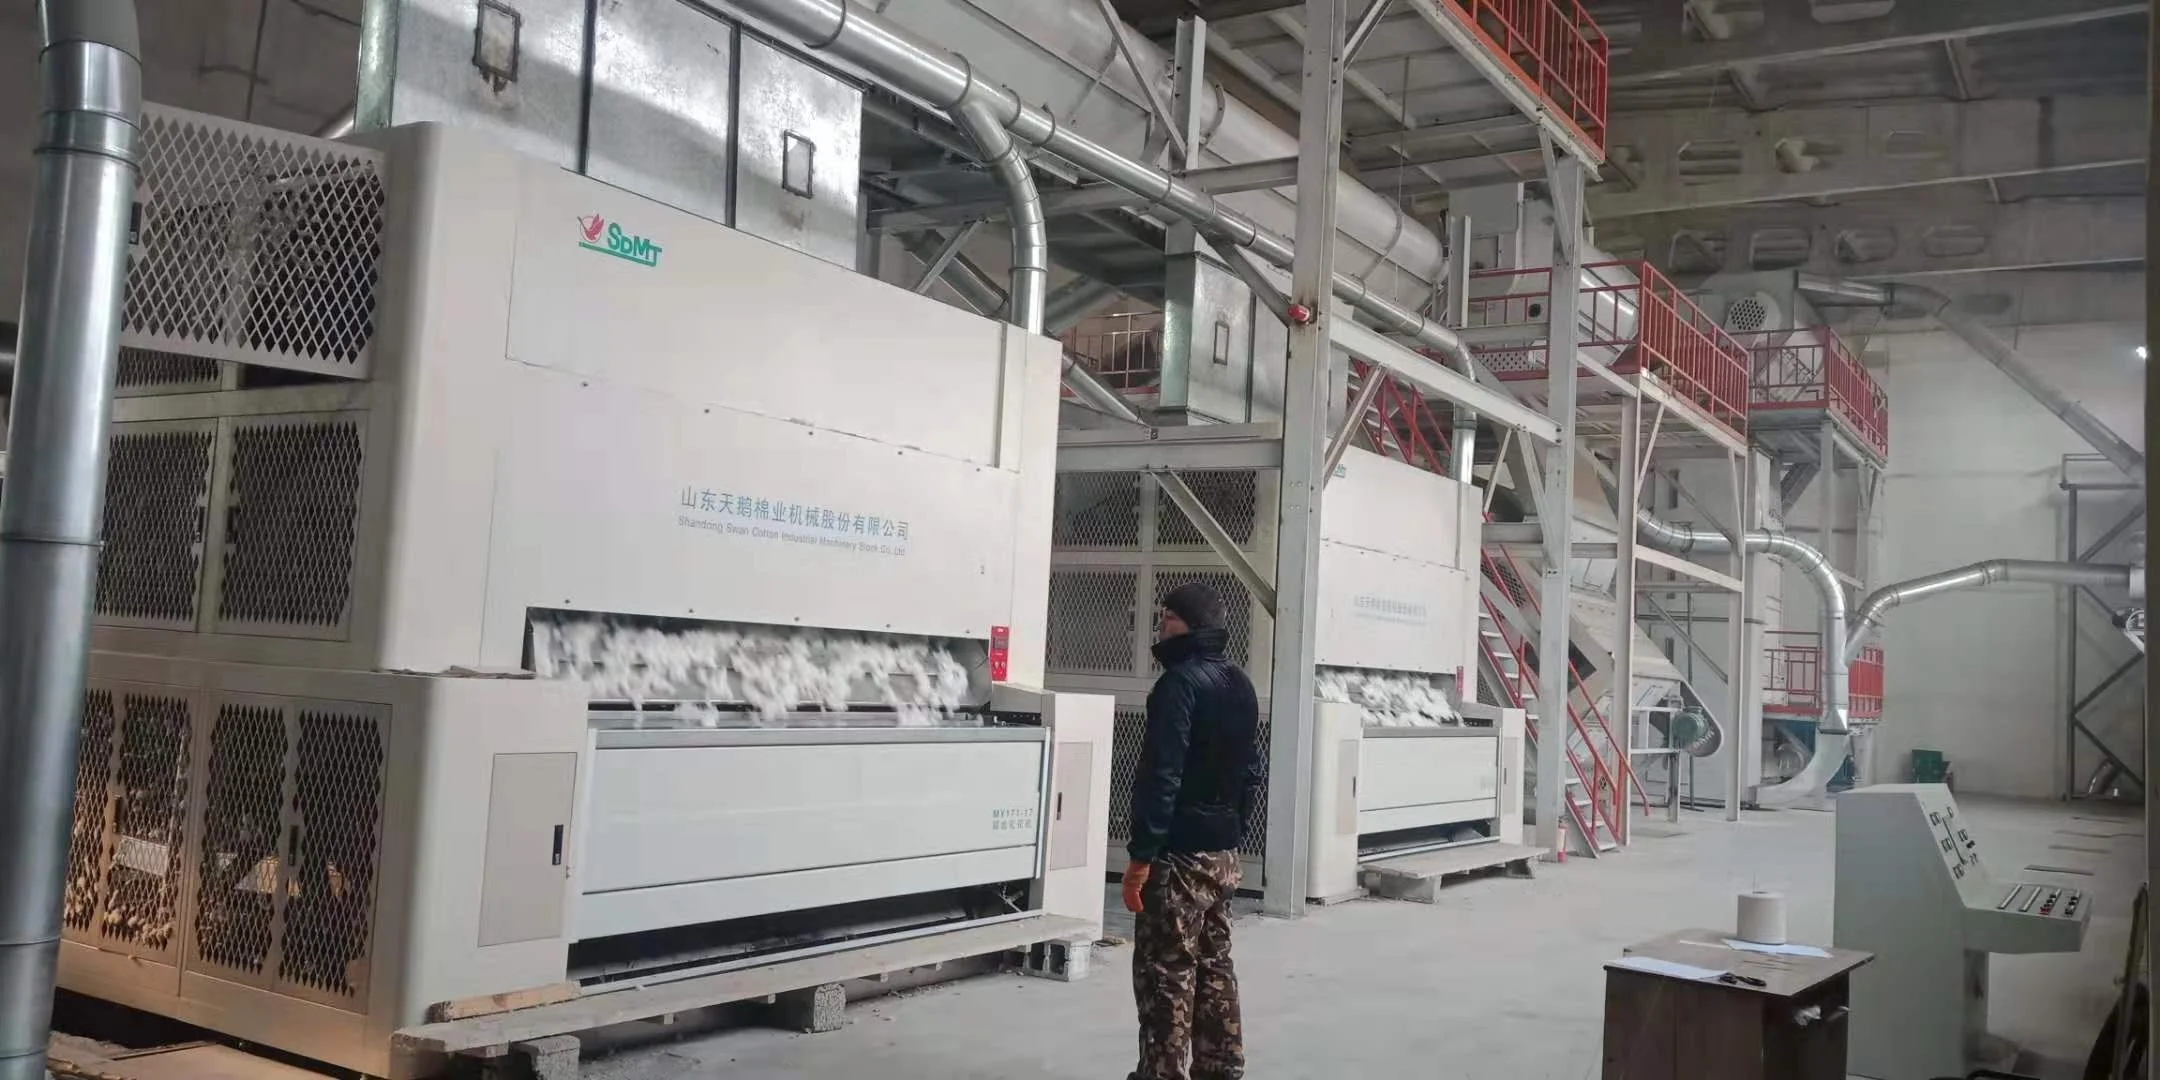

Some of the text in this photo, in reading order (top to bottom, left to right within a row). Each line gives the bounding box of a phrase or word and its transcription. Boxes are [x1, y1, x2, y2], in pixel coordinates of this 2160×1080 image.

[678, 515, 723, 534] Shandong
[726, 522, 748, 536] Swan
[681, 485, 909, 540] 山东天鹅棉业机械股份有限公司
